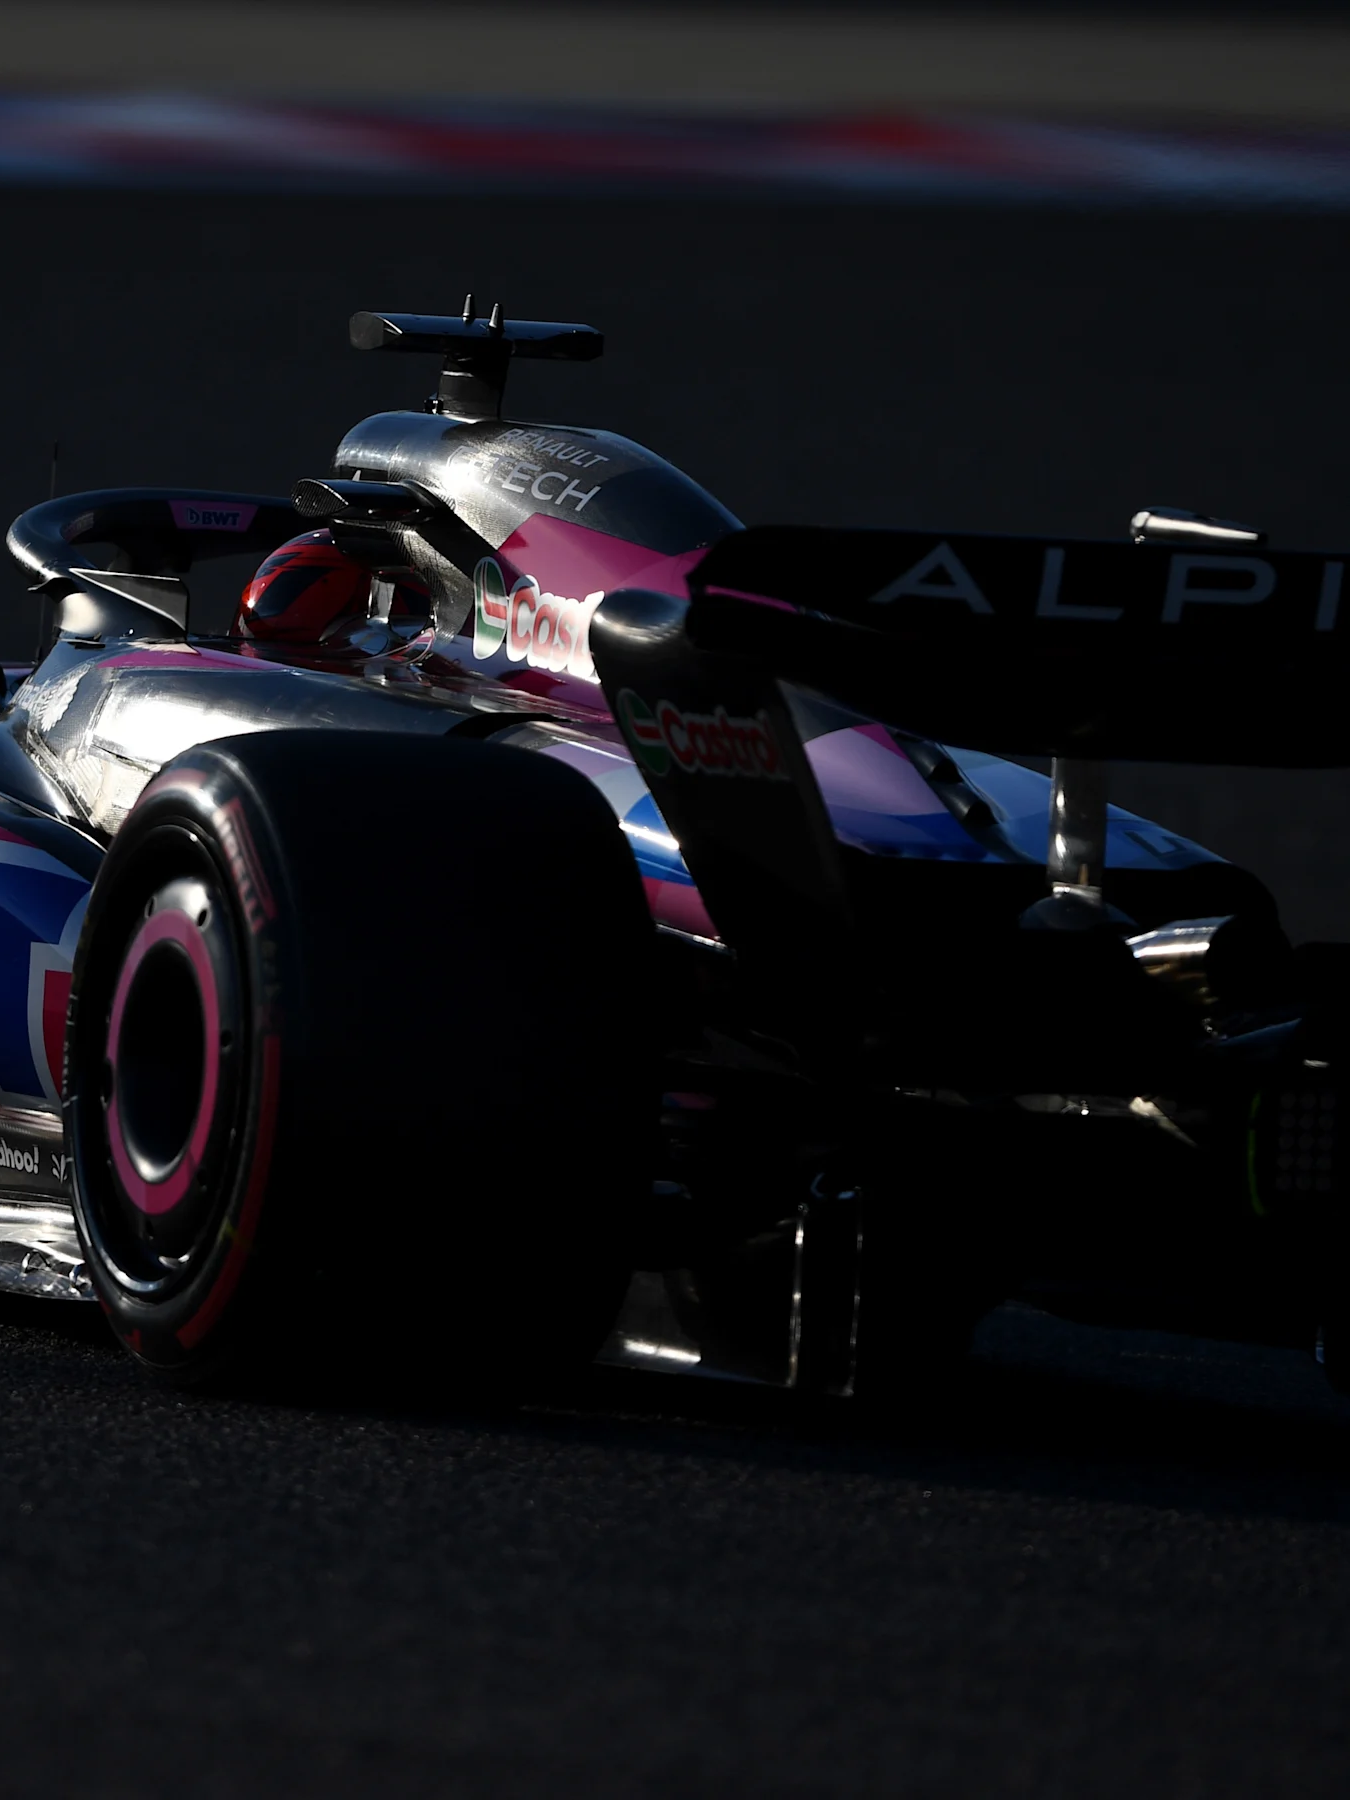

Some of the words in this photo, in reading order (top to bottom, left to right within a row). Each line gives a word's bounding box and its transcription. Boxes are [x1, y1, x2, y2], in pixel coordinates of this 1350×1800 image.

[496, 428, 610, 468] RENAULT
[202, 509, 240, 526] BWT
[509, 580, 595, 672] Cast
[656, 702, 789, 780] Castrol
